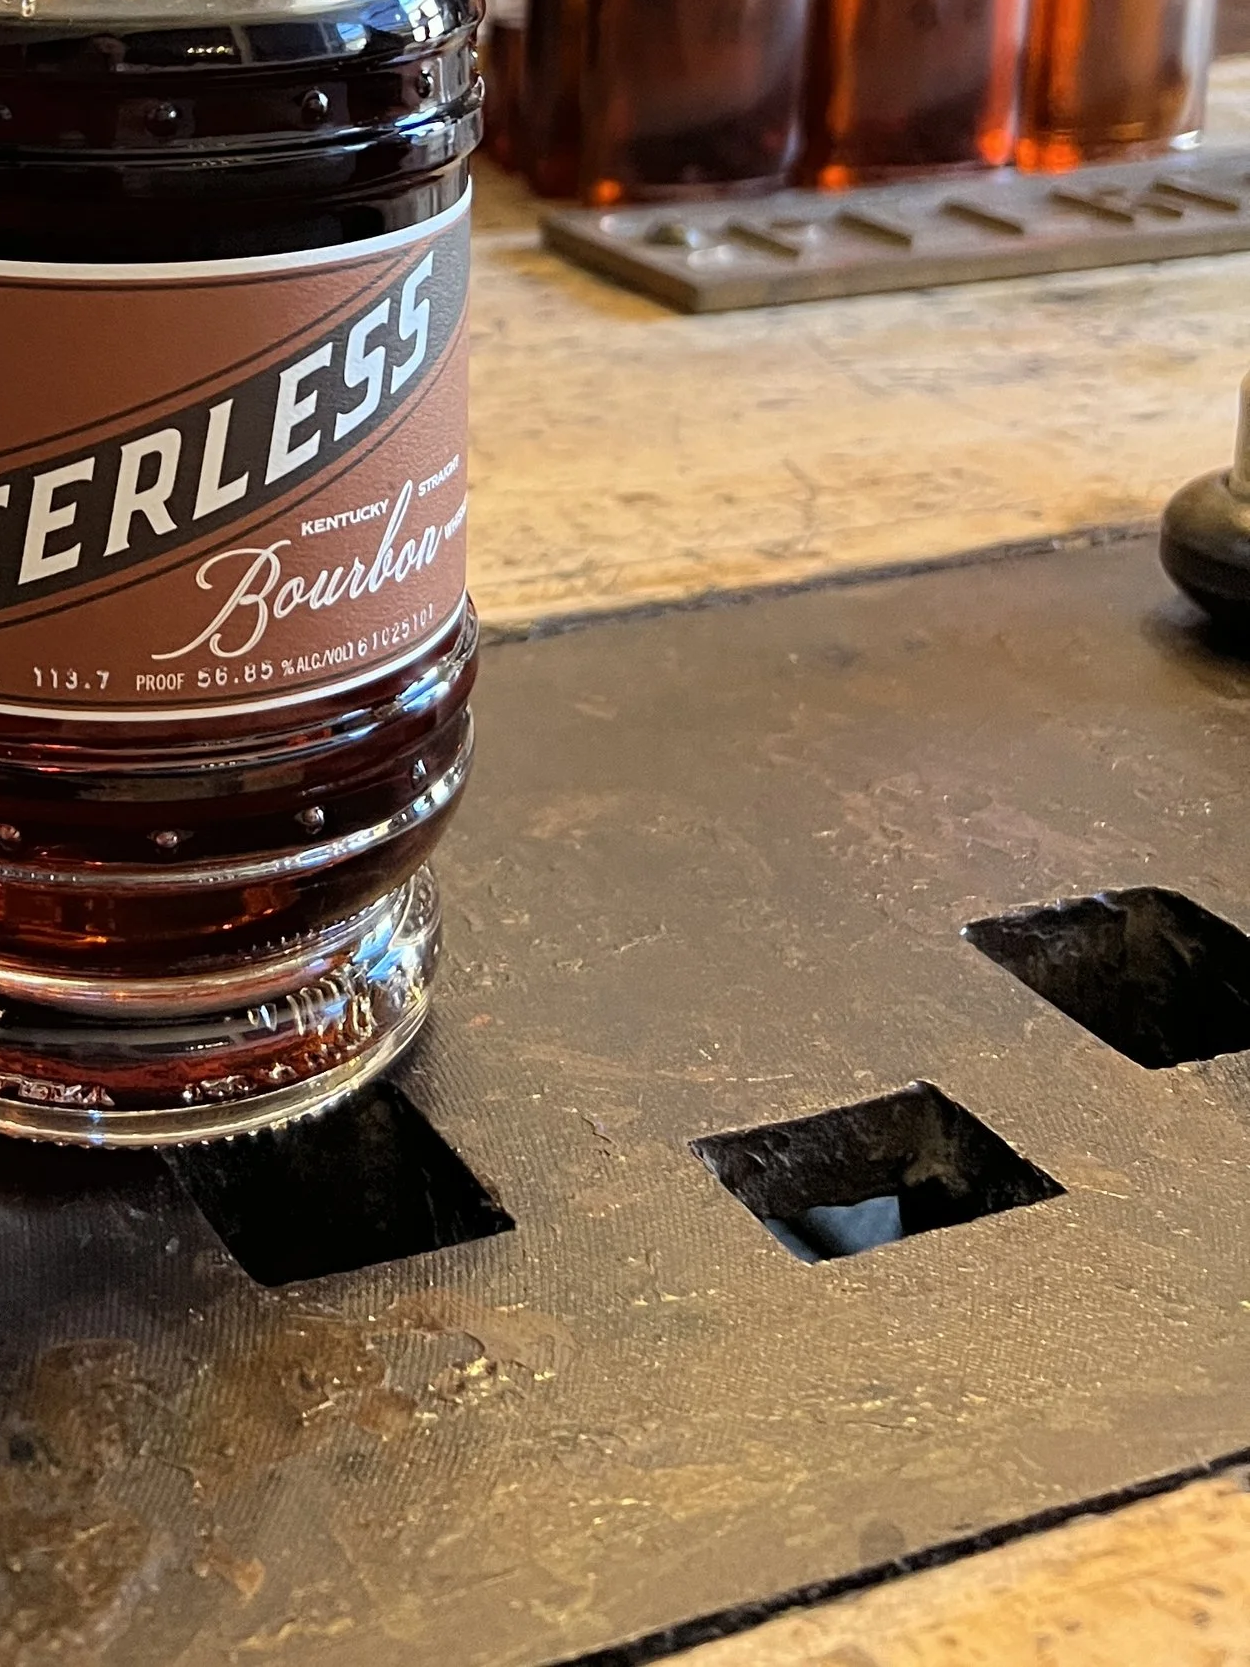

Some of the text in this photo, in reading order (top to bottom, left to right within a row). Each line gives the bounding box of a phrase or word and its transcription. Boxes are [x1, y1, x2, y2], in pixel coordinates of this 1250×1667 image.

[301, 498, 390, 537] KENTUCKY
[151, 479, 442, 659] Bourbon
[33, 666, 110, 689] 113.7
[136, 673, 185, 691] PROOF
[197, 659, 275, 689] 56.85
